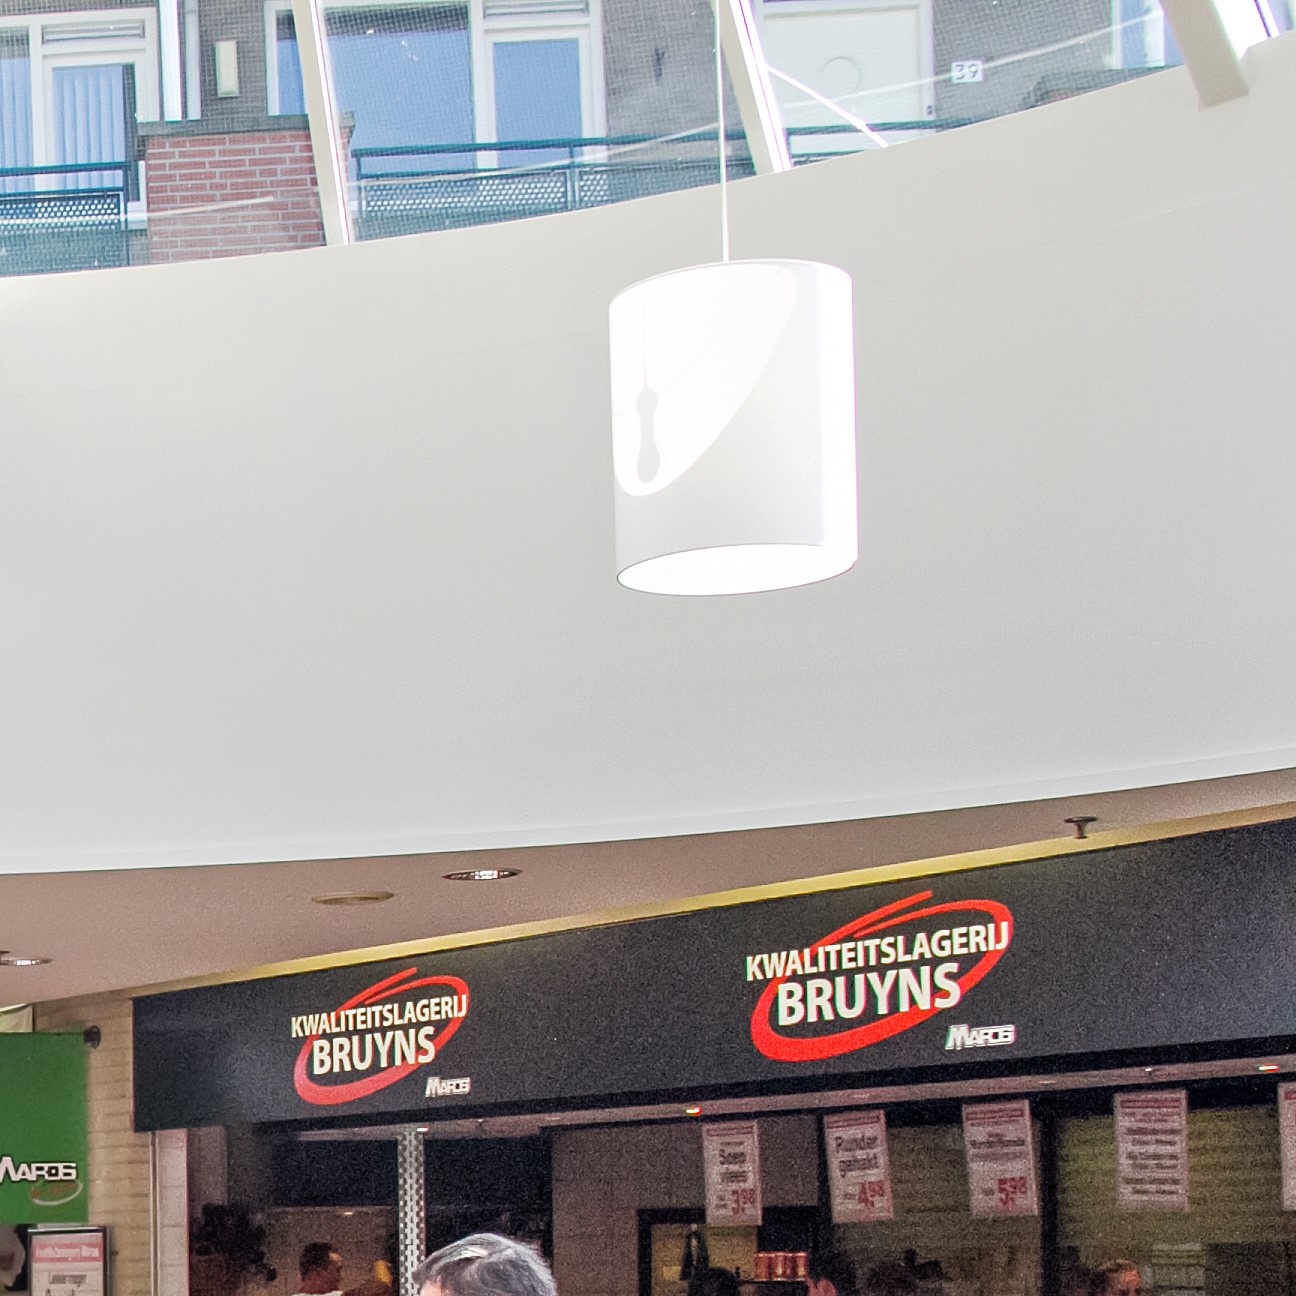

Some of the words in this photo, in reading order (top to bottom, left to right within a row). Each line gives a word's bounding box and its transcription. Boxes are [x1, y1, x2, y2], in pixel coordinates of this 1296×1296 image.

[954, 63, 980, 80] 39
[746, 921, 1010, 982] KWALITEITSLAGERIJ
[291, 994, 468, 1038] KWALITEITSLAGERIJ
[777, 962, 962, 1026] BRUYNS
[313, 1026, 436, 1075] BRUYNS
